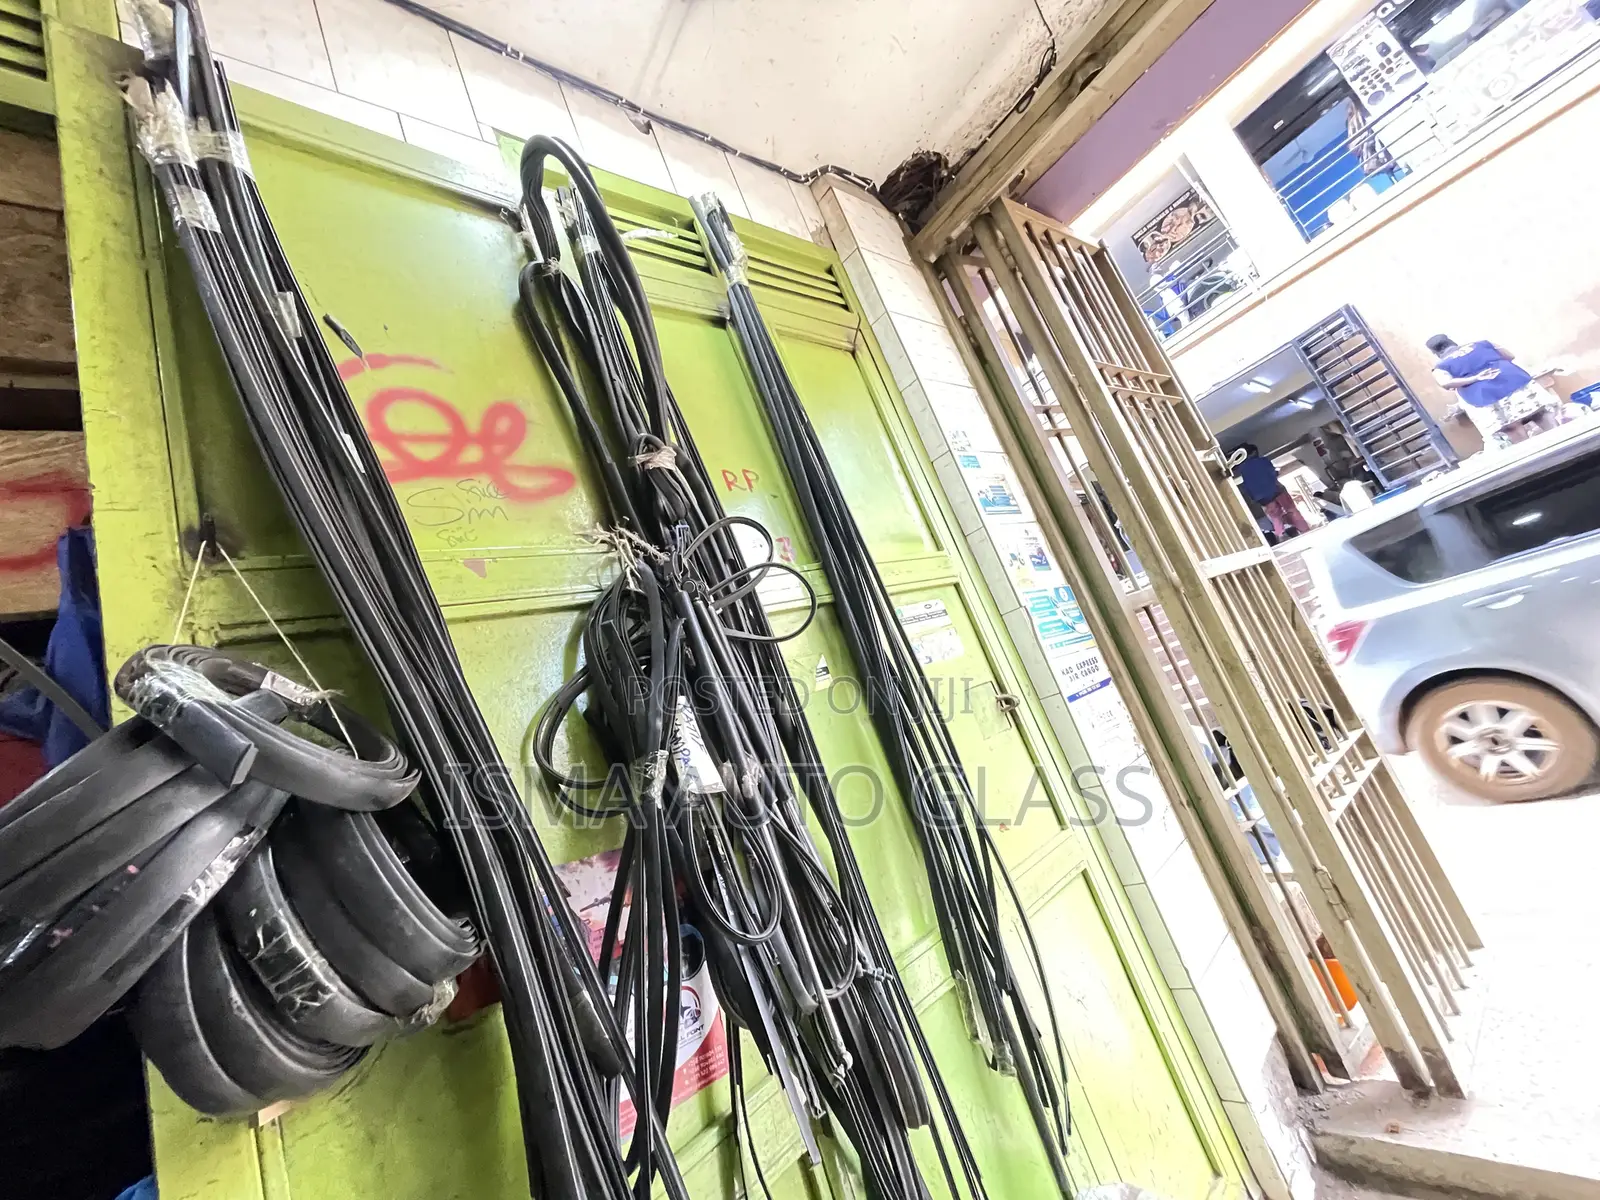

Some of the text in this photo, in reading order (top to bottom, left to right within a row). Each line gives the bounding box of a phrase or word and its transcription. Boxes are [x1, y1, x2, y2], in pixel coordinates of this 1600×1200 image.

[721, 468, 760, 492] RP
[1075, 656, 1099, 671] EXPRESS
[1081, 664, 1100, 677] CARGO
